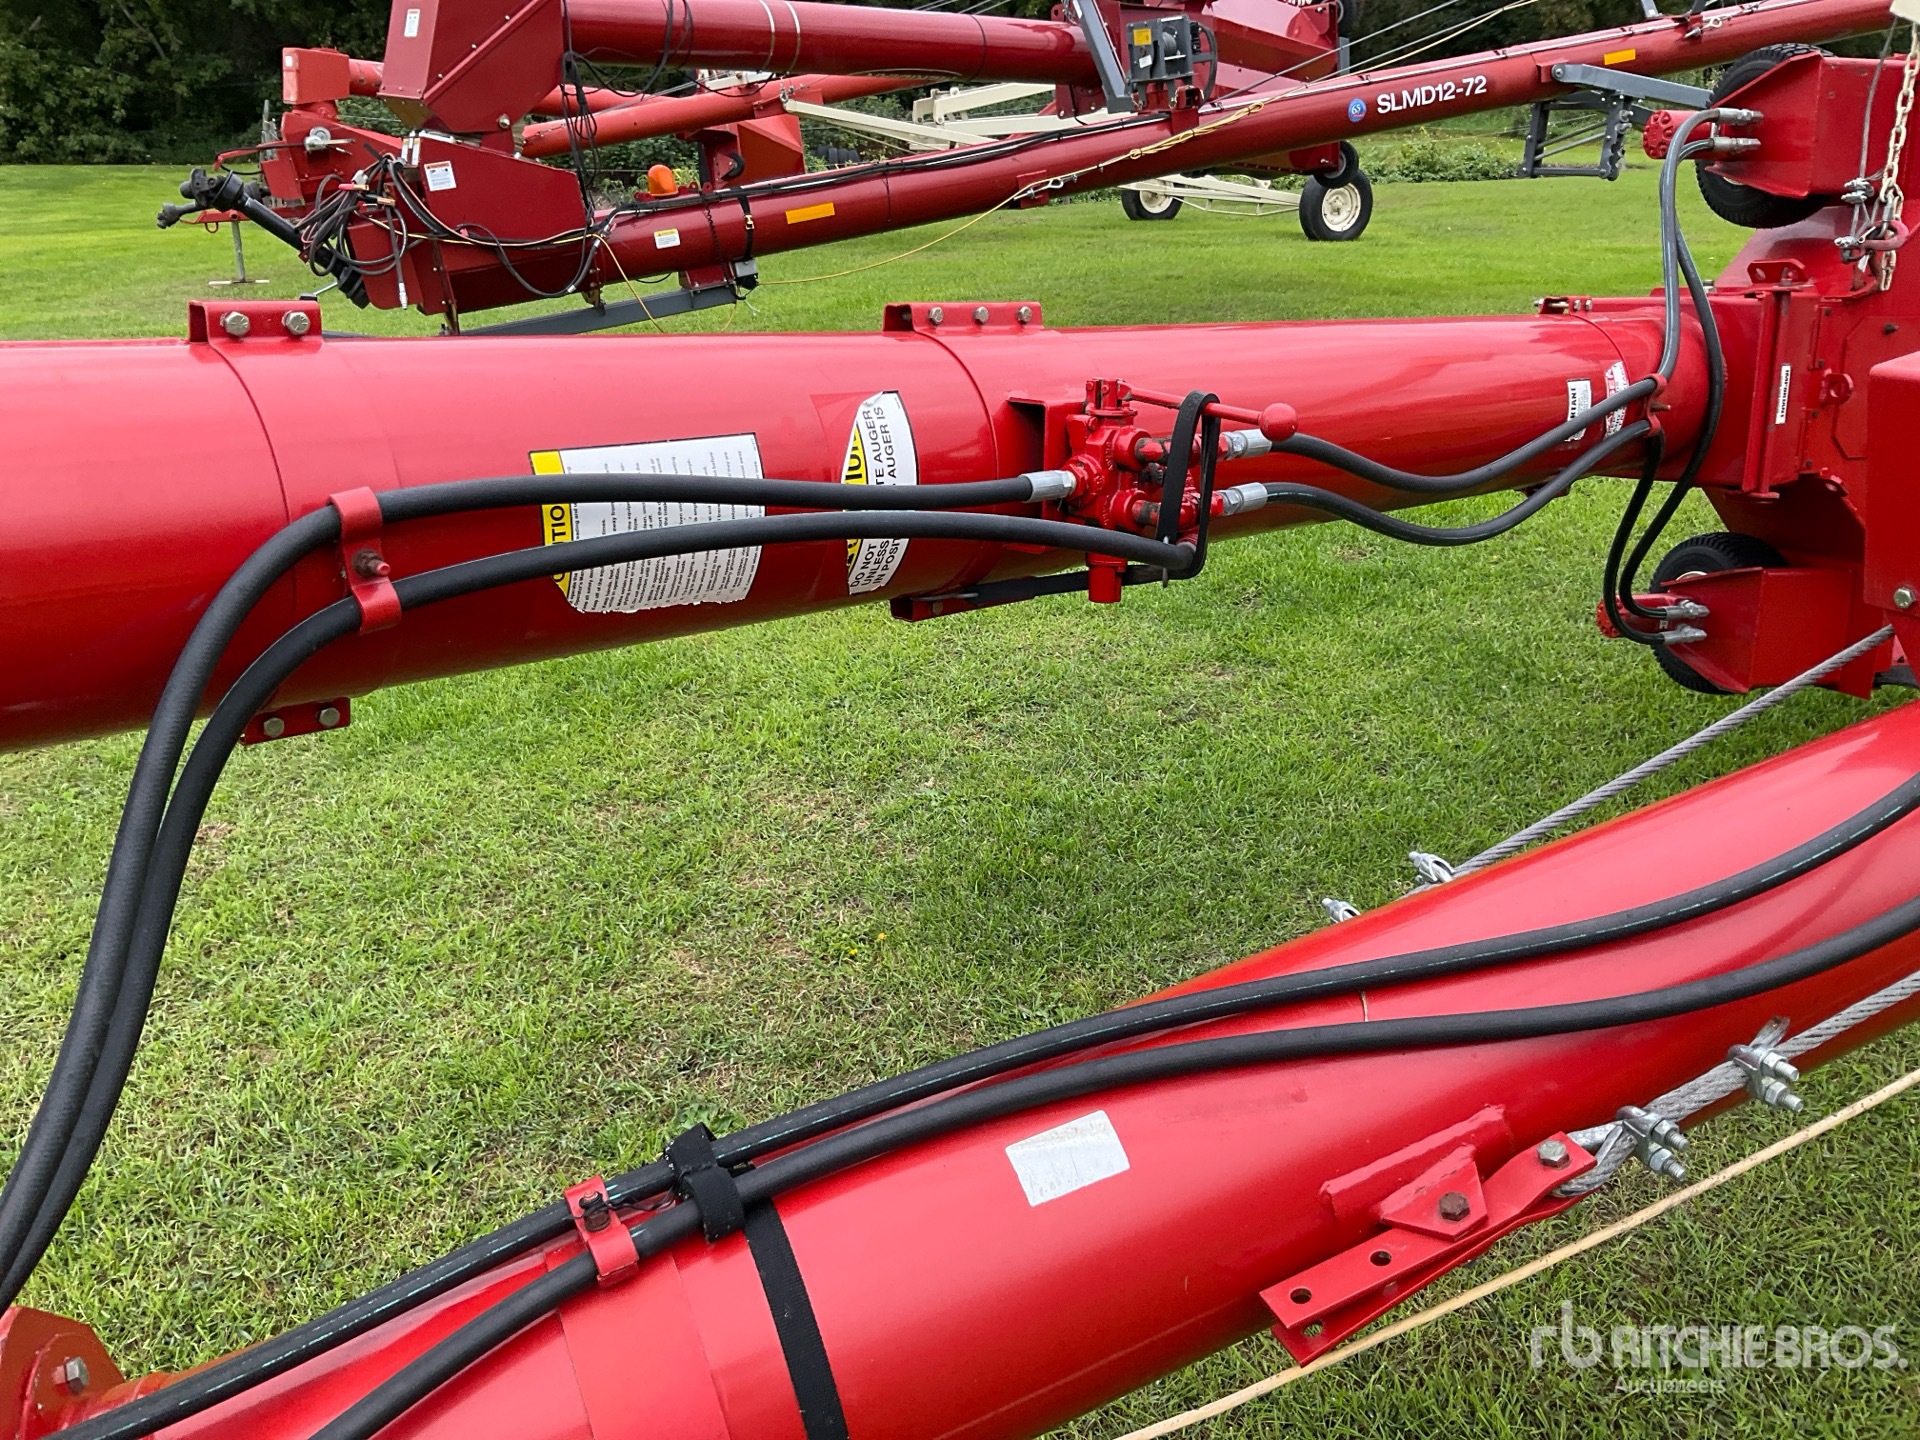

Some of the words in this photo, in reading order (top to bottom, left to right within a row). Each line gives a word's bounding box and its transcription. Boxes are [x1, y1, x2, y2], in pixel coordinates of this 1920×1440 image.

[1377, 75, 1487, 114] SLMD12-72
[874, 407, 885, 420] IS
[863, 410, 883, 463] AUGER
[879, 424, 897, 479] AUGER
[860, 544, 877, 570] NOT
[861, 540, 889, 586] UNLESS
[850, 572, 865, 587] DO
